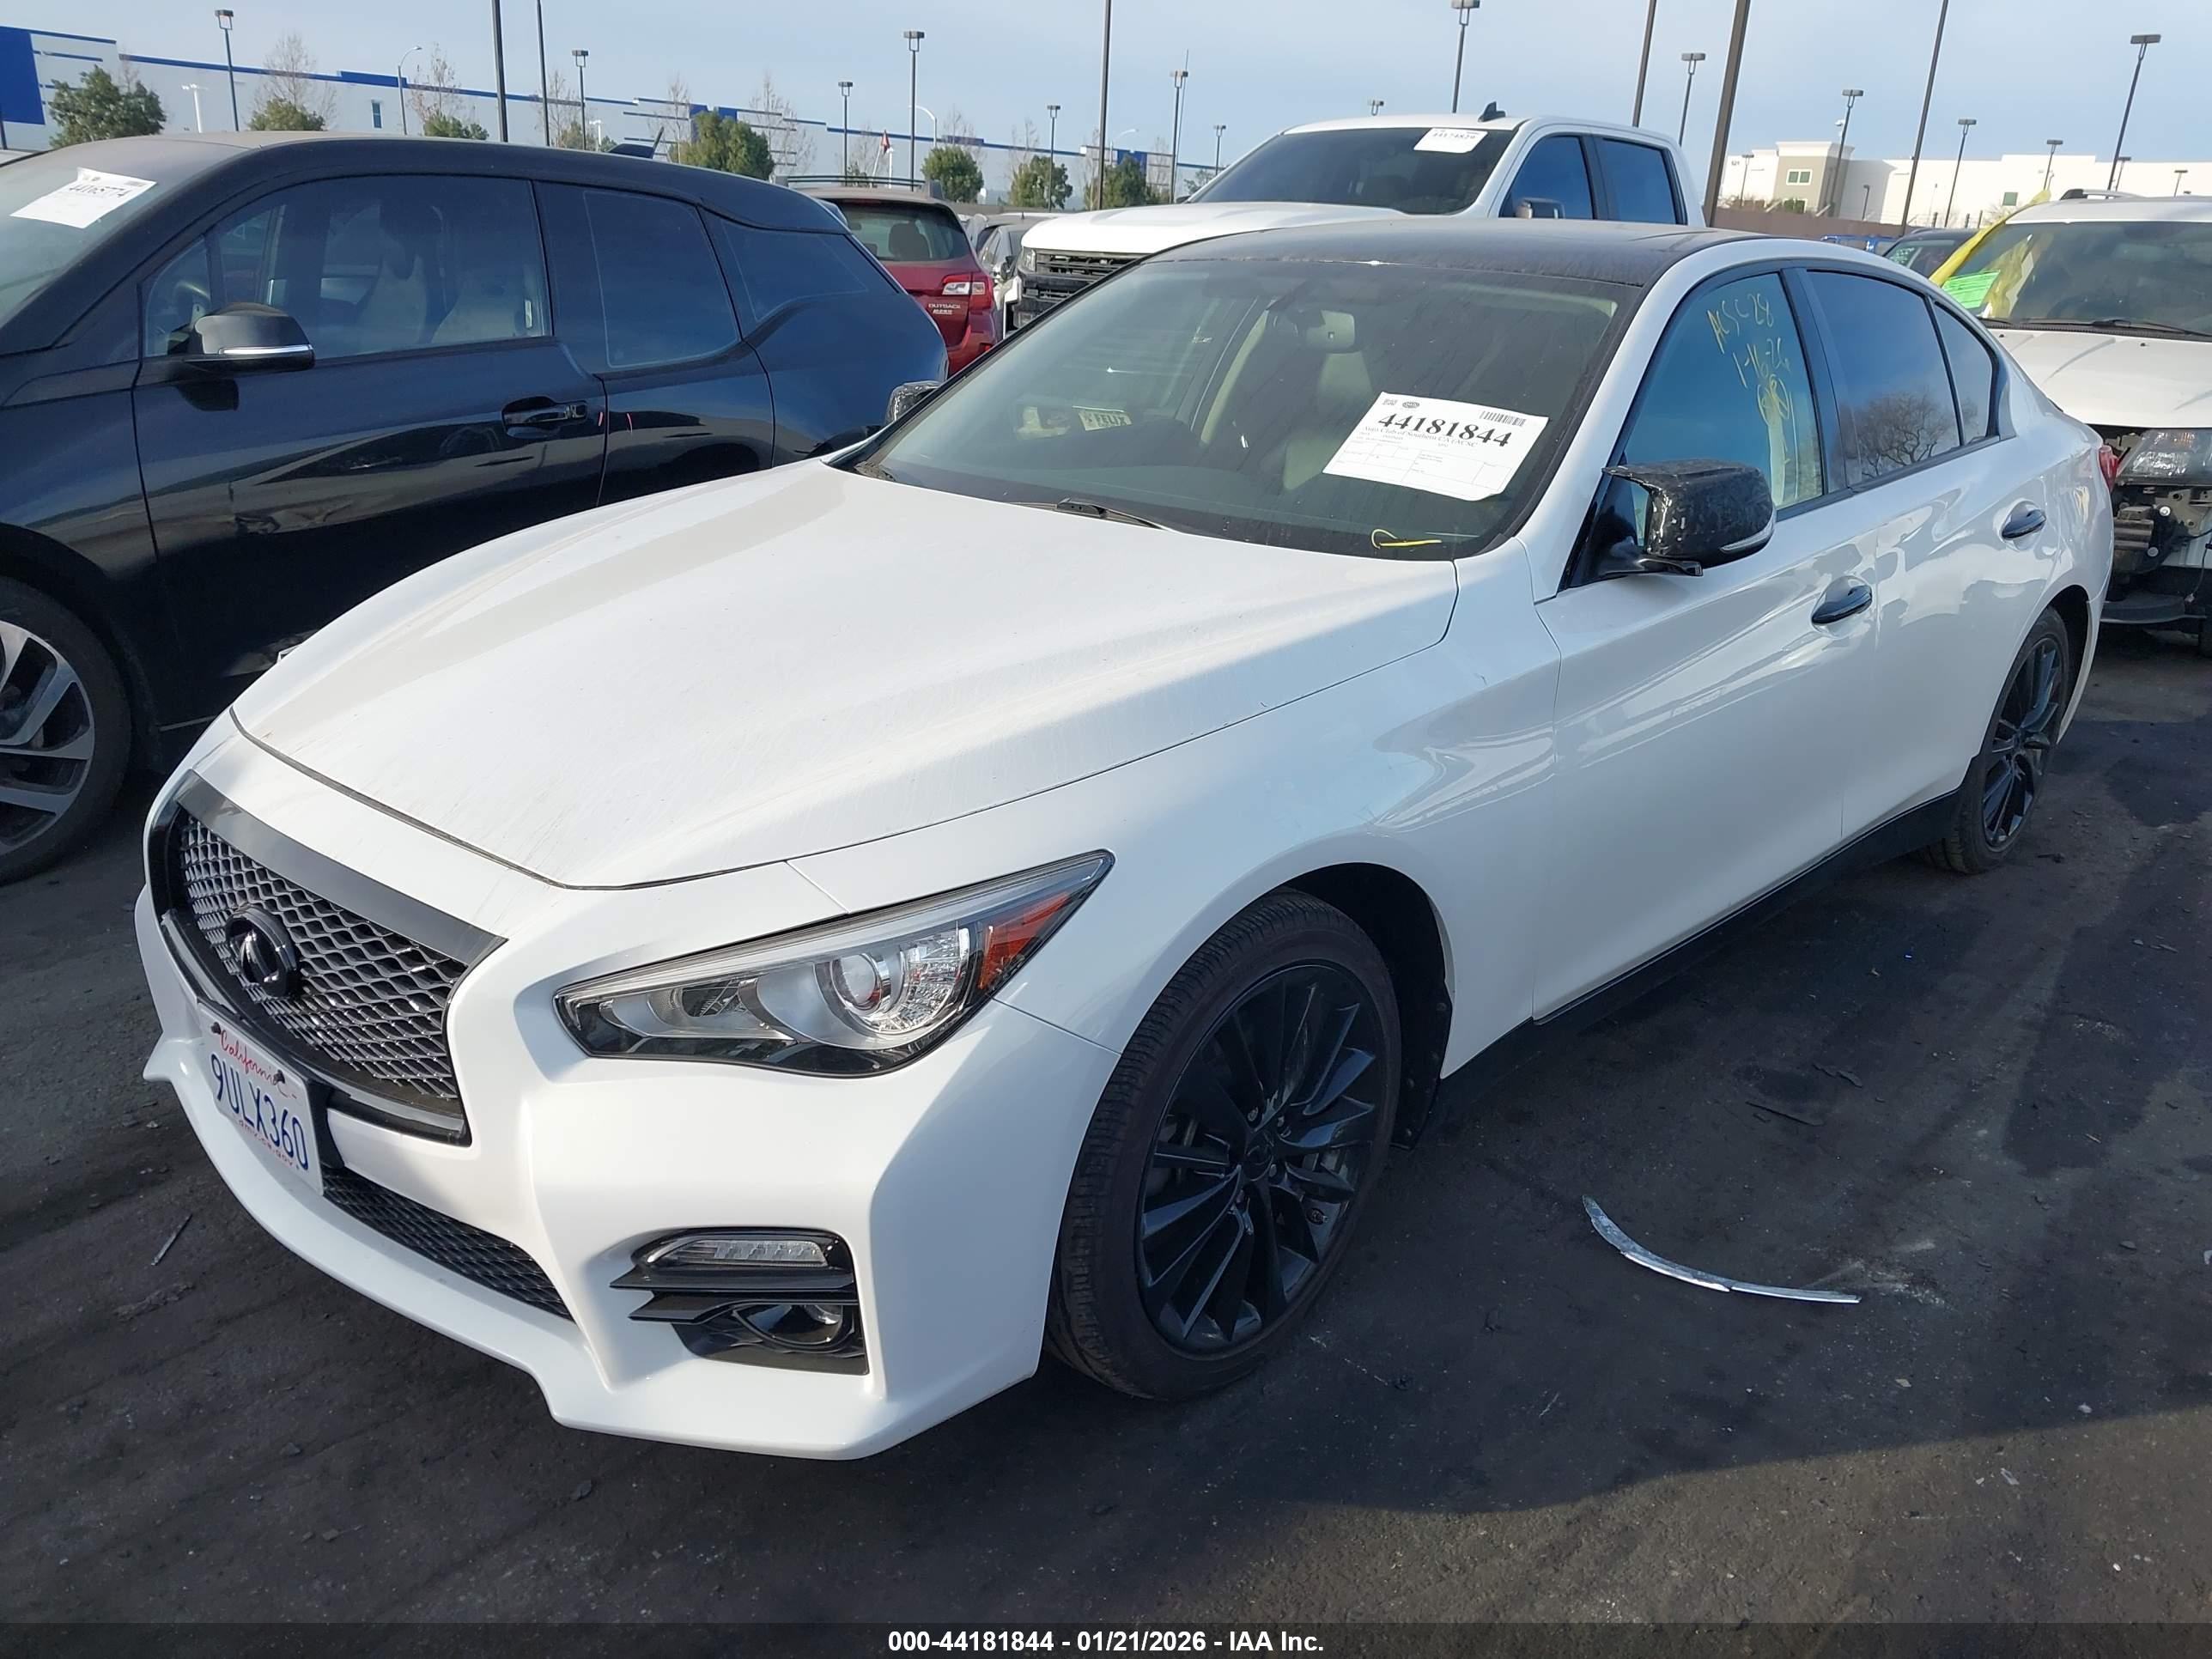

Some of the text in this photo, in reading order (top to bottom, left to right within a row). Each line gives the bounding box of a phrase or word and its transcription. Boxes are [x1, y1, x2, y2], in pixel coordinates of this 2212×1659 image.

[1094, 412, 1127, 427] FELIX
[1378, 413, 1512, 447] 44181844
[1380, 427, 1397, 435] Club
[211, 1054, 308, 1171] 9ULX360
